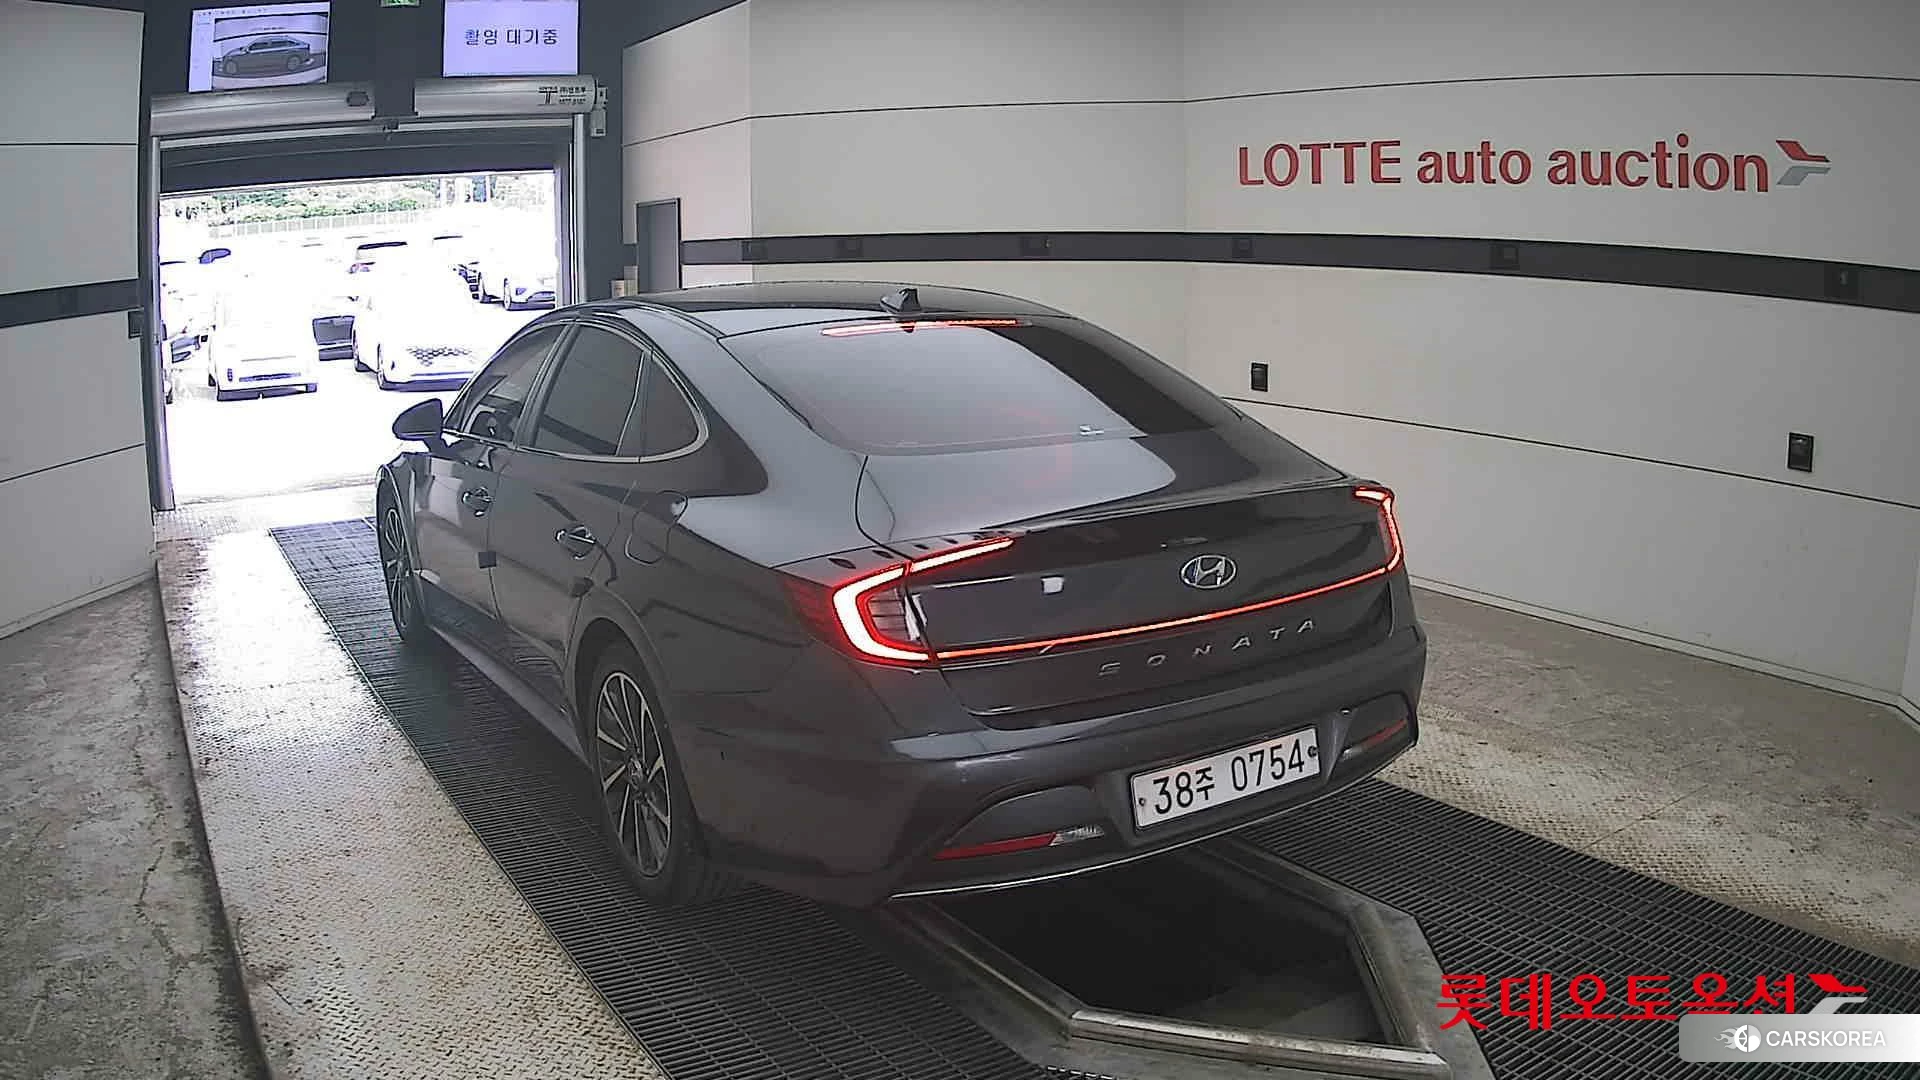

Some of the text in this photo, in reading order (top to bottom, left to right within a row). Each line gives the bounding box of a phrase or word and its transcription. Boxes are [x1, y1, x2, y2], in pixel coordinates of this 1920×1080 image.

[506, 29, 557, 45] 대기중
[1239, 133, 1769, 192] LOTTE auto auction
[1098, 619, 1314, 676] SONATA
[1152, 739, 1305, 815] 38주 0754
